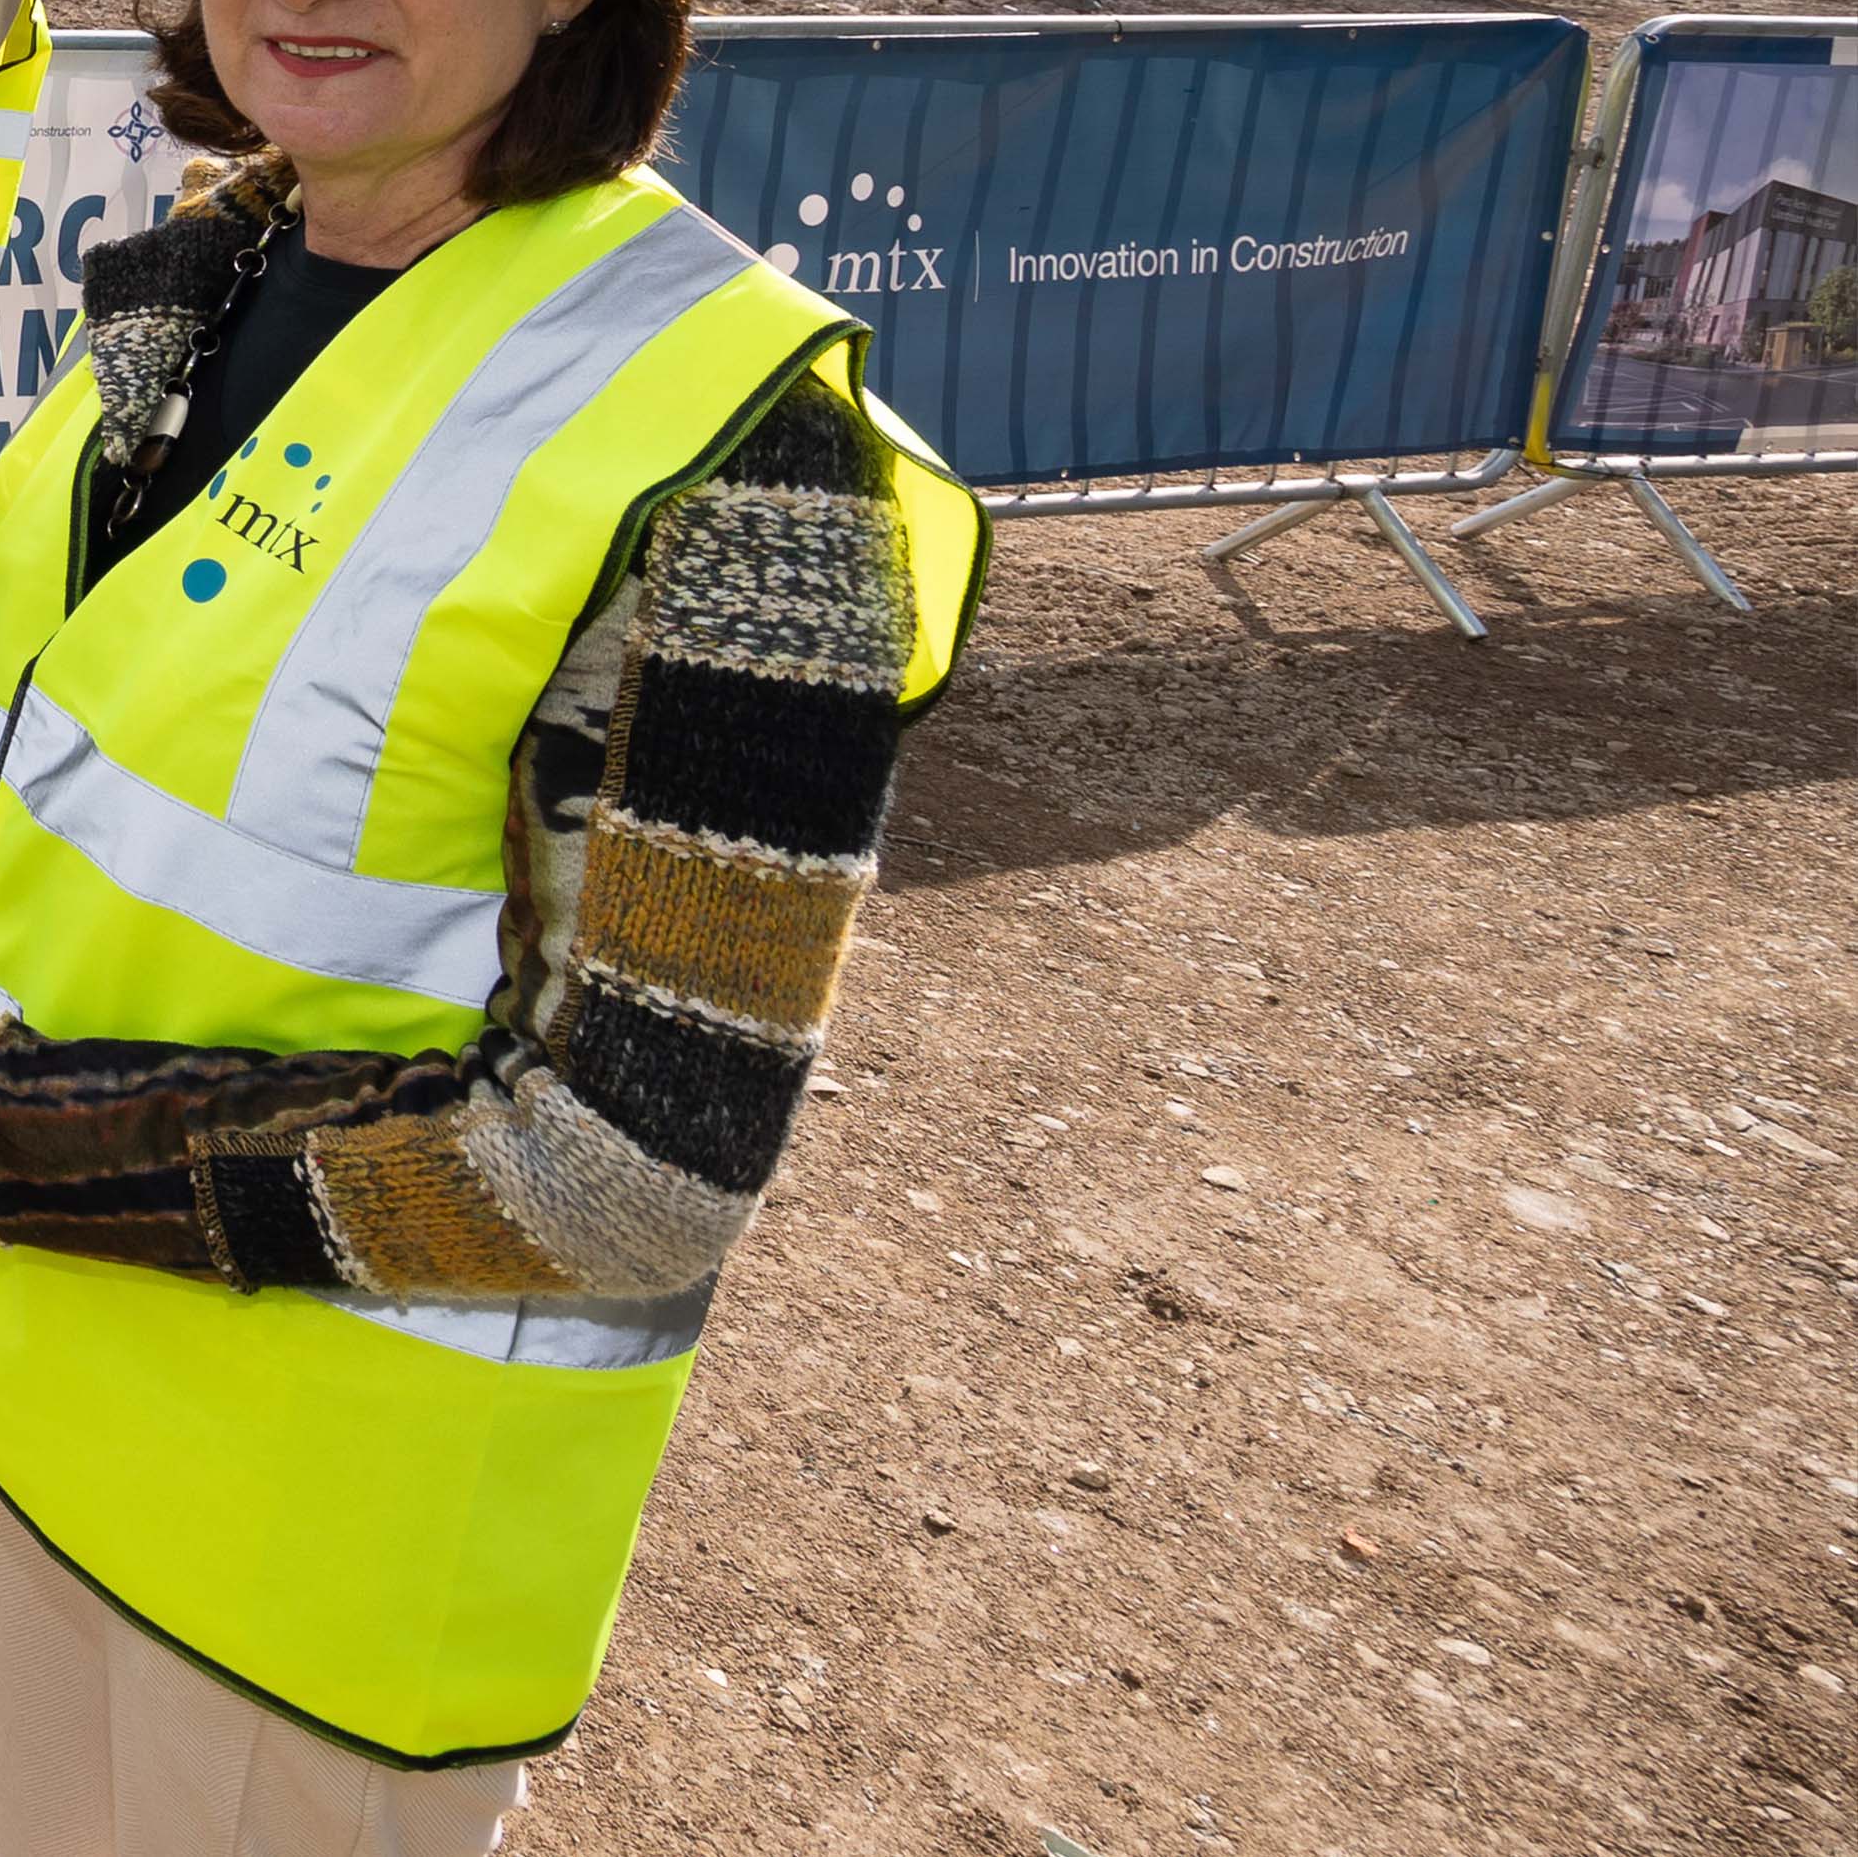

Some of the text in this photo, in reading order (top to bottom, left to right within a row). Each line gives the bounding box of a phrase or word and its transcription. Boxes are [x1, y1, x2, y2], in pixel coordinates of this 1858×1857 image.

[30, 125, 92, 137] onstruction
[821, 224, 1410, 295] mtx Innovation in Construction
[215, 493, 320, 574] mtx
